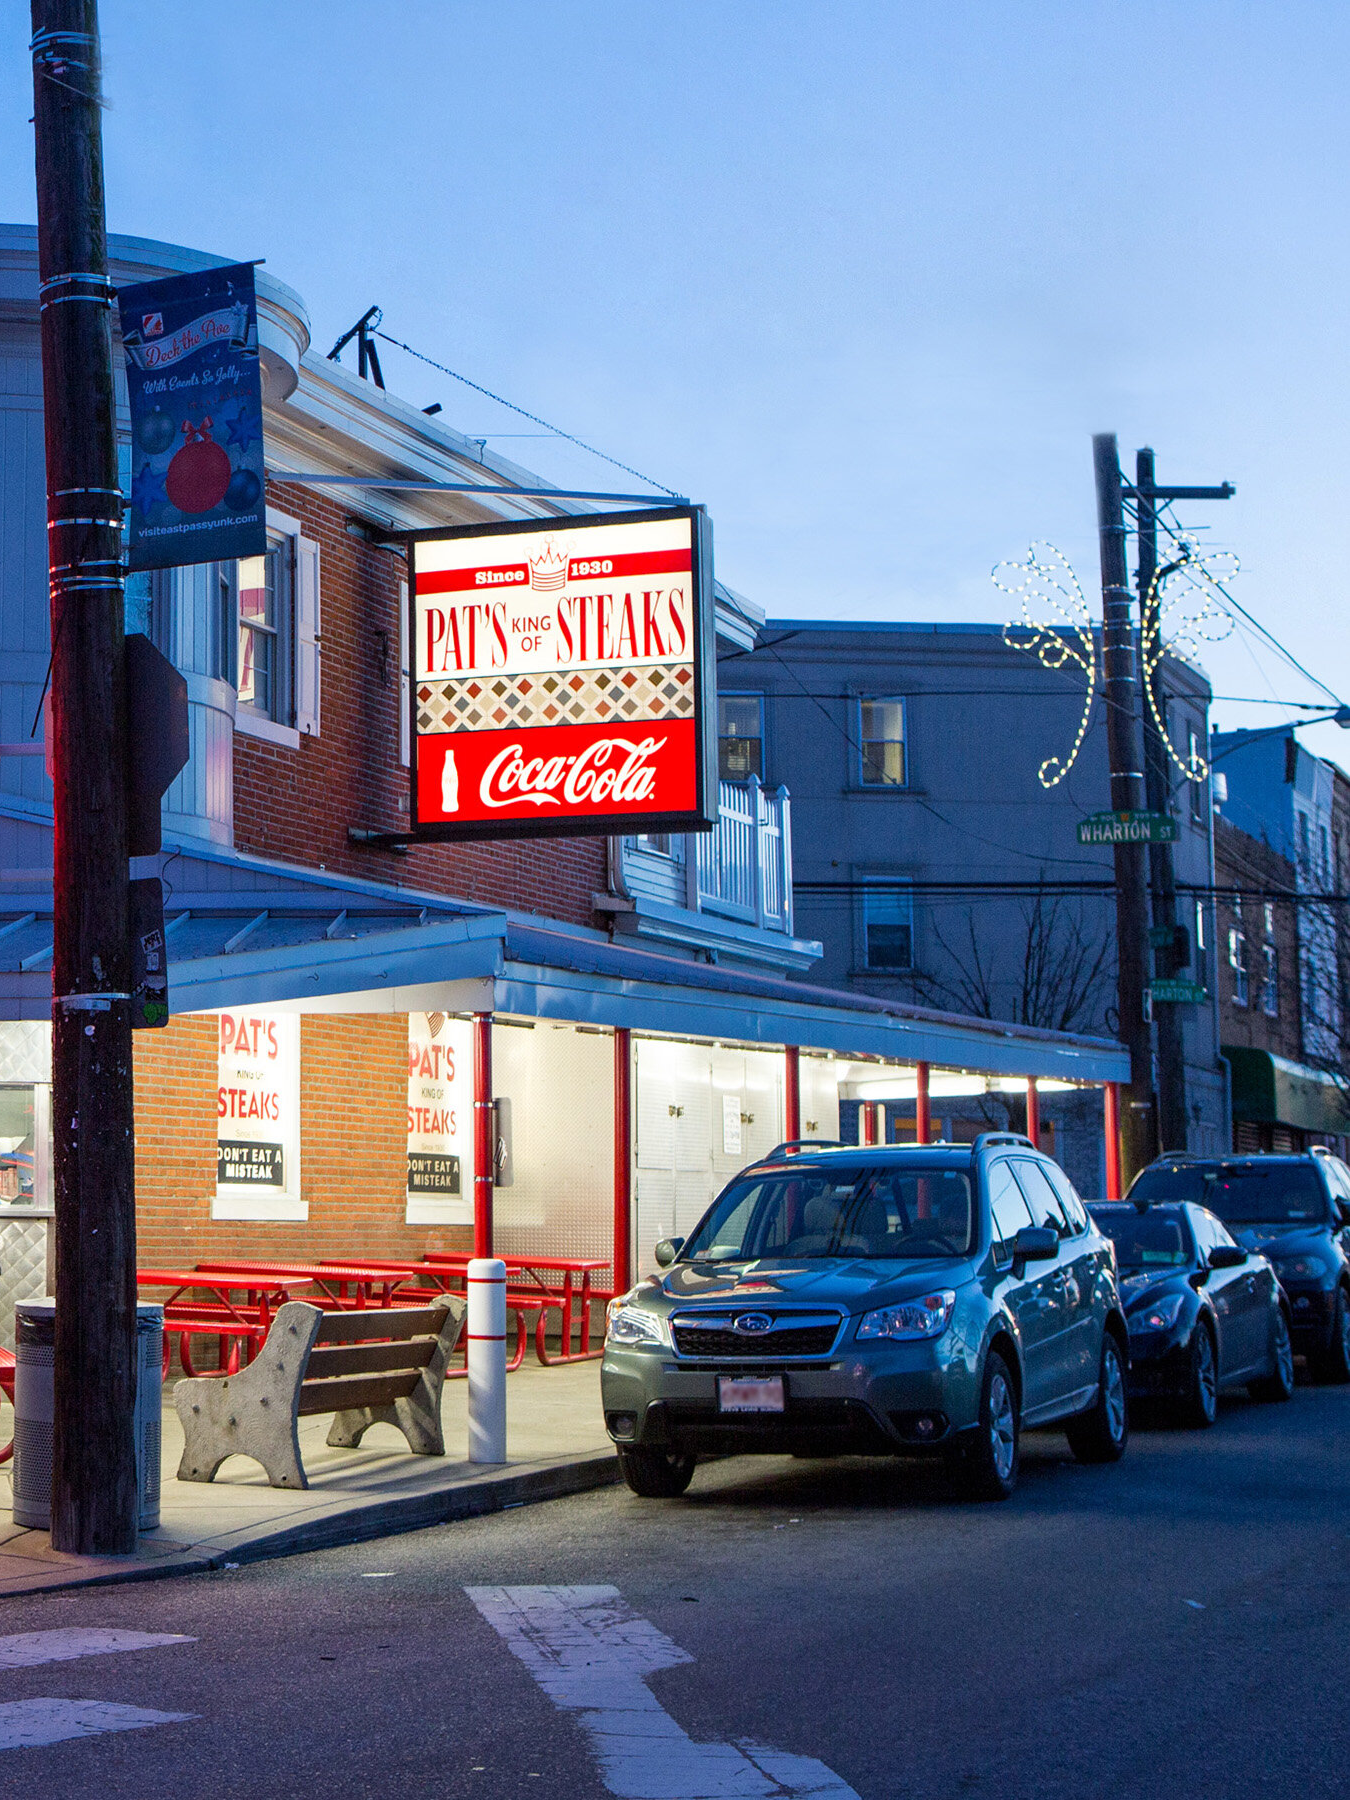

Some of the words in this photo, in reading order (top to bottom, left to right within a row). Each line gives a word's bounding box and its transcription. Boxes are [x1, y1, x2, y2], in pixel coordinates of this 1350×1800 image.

[146, 338, 182, 366] Deck
[178, 330, 201, 351] the
[201, 318, 231, 339] Ave
[143, 376, 167, 394] With
[202, 369, 214, 385] So
[138, 513, 258, 538] visiteastpassyunk.com
[475, 569, 525, 586] Since
[571, 559, 613, 577] 1930
[512, 615, 551, 633] KING
[556, 588, 686, 664] STEAKS
[424, 601, 508, 673] PAT'S
[521, 636, 543, 653] OF
[479, 736, 668, 808] Coca-Cola
[1080, 821, 1151, 842] WHARTON
[1159, 825, 1172, 839] ST
[221, 1014, 278, 1060] PAT'S
[409, 1042, 455, 1082] PAT'S
[218, 1087, 280, 1121] STEAKS
[421, 1087, 437, 1099] KING
[438, 1088, 445, 1099] OF
[408, 1107, 456, 1136] STEAKS
[217, 1146, 249, 1162] DON'T
[251, 1148, 273, 1163] EAT
[274, 1149, 282, 1163] A
[434, 1160, 451, 1173] EAT
[453, 1161, 459, 1173] A
[226, 1163, 273, 1179] MISTEAK
[413, 1173, 452, 1187] MISTEAK
